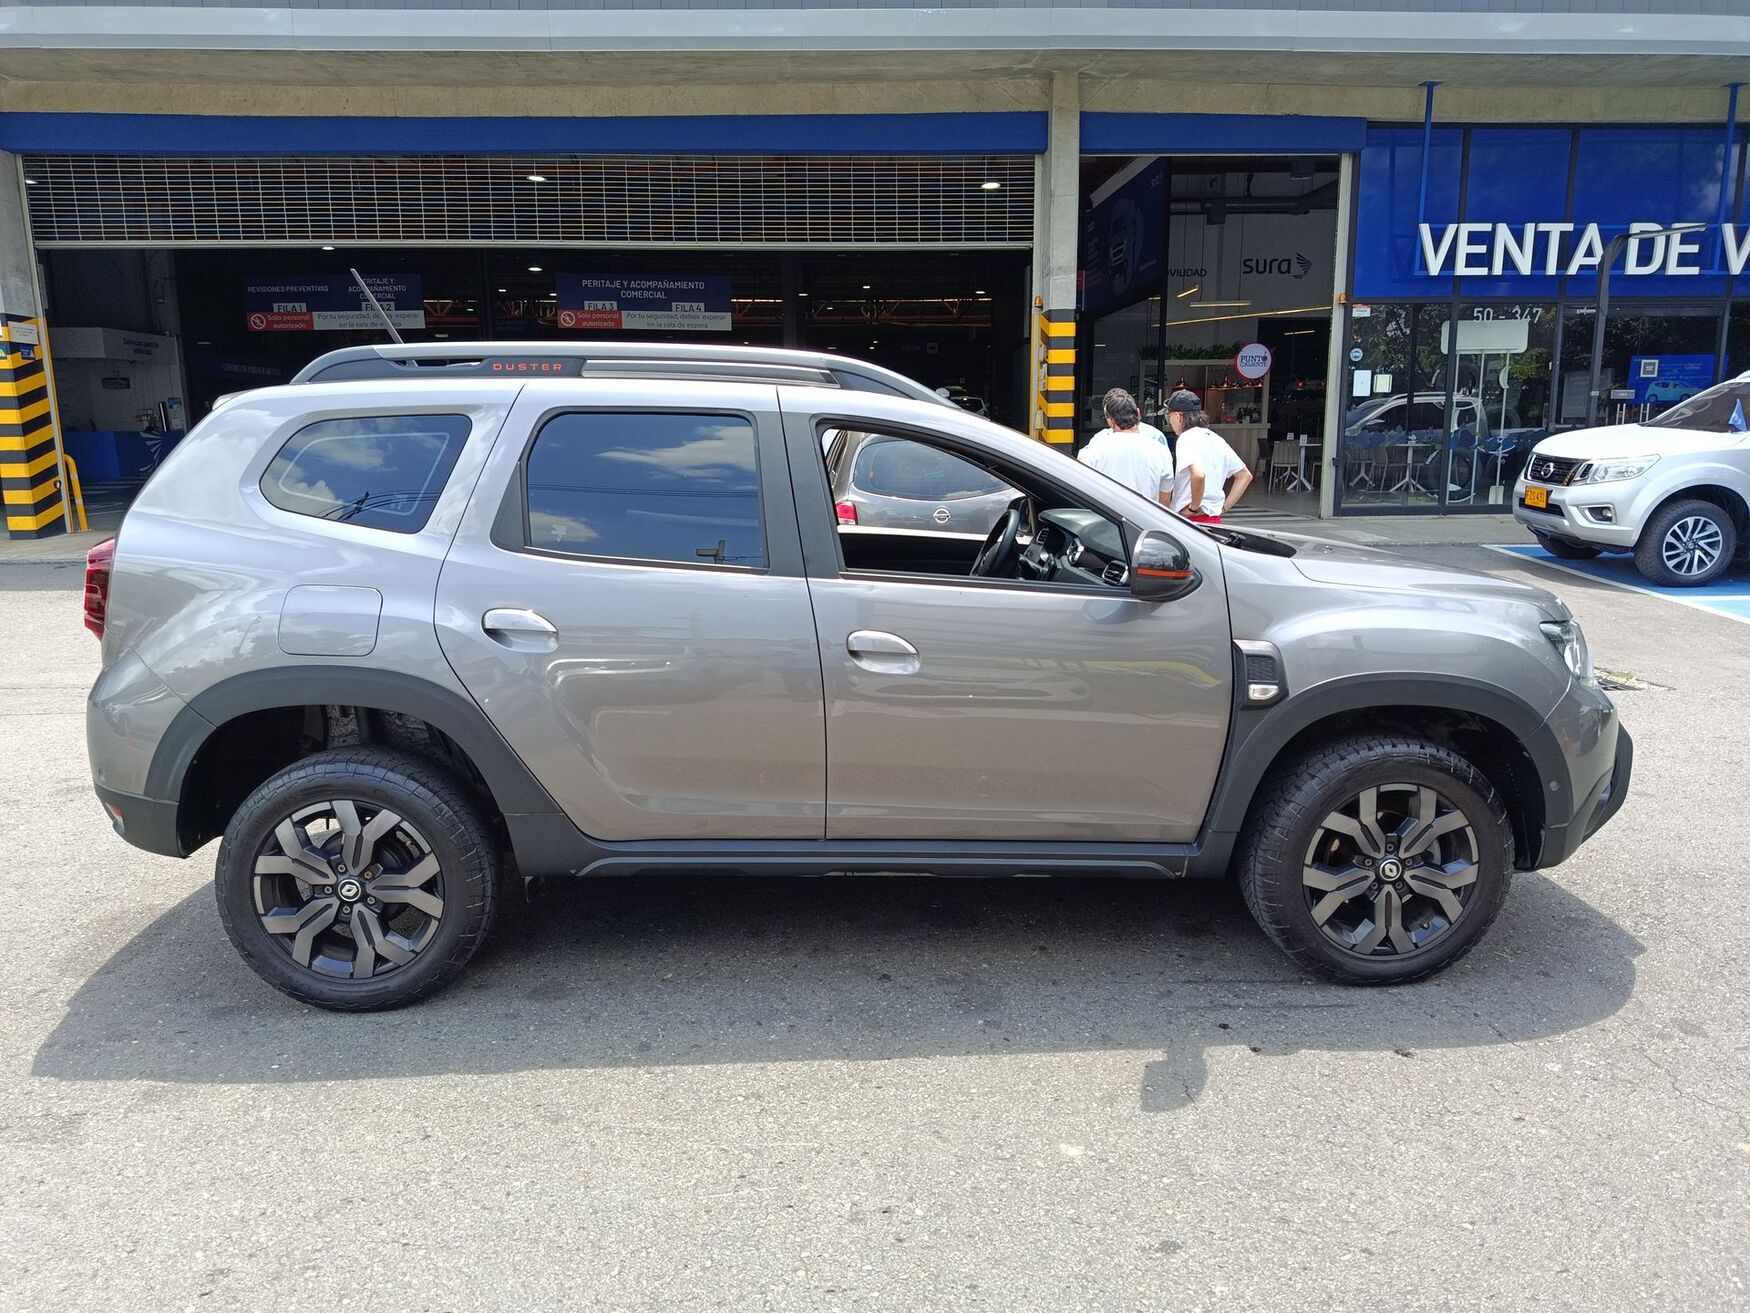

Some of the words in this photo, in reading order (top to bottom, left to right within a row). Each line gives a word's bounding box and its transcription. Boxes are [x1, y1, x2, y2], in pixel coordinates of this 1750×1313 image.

[1418, 223, 1604, 276] VENTA
[1624, 222, 1702, 276] DE
[1242, 257, 1292, 275] sura
[1167, 268, 1208, 278] VILIDAD
[247, 285, 285, 293] REVISIONES
[285, 285, 329, 293] PREVENTIVAS
[582, 279, 621, 288] PERITAJE
[622, 280, 628, 288] Y
[629, 279, 705, 290] ACOMPAÑAMIENTO
[620, 290, 667, 299] COMERCIAL
[277, 304, 298, 313] FILA
[386, 303, 393, 312] 2
[587, 302, 607, 311] FILA
[609, 302, 615, 311] 3
[675, 304, 694, 313] FILA
[696, 304, 702, 313] 4
[282, 314, 310, 322] personal
[592, 311, 620, 321] personal
[1473, 307, 1494, 323] 50
[582, 320, 615, 328] autorizado
[492, 363, 563, 372] DUSTER
